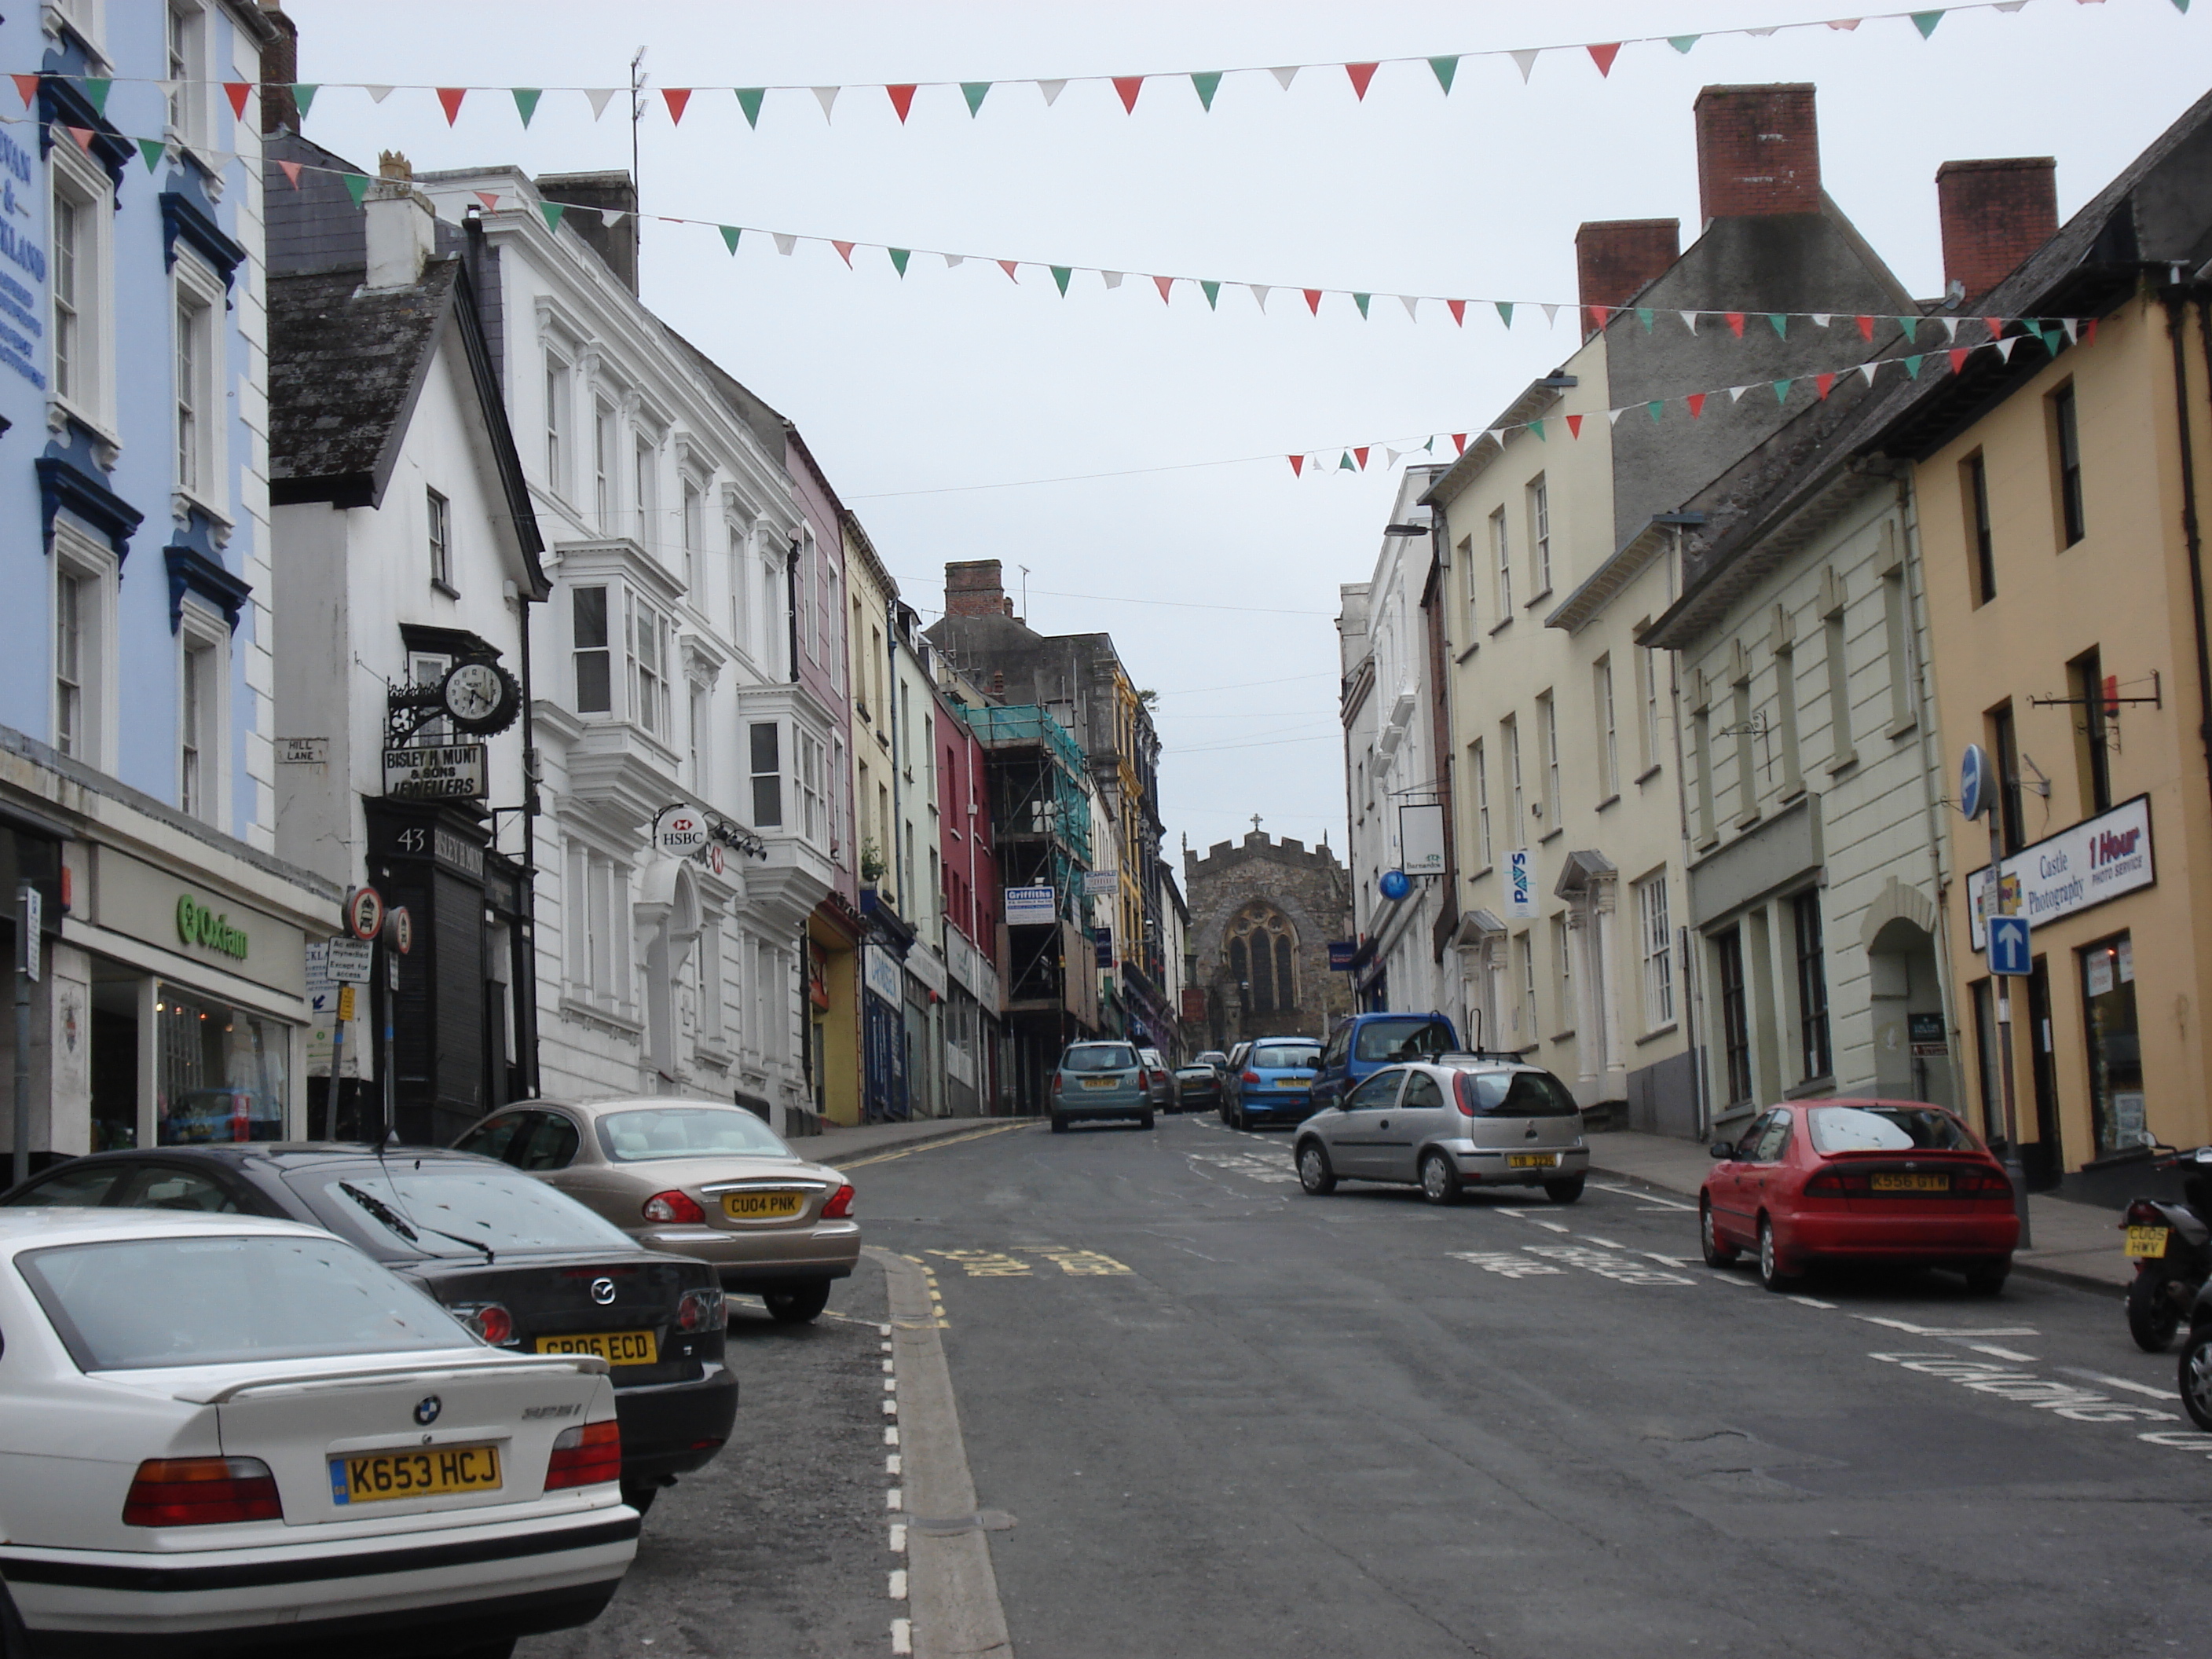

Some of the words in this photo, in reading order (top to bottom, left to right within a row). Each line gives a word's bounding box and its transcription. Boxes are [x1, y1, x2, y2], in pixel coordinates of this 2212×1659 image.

[287, 751, 313, 760] LANE
[288, 740, 313, 750] HILL
[386, 751, 426, 769] BISLEY
[430, 749, 438, 766] H
[443, 747, 478, 765] MUNT
[423, 766, 456, 778] SONS
[390, 778, 474, 798] JEWELLERS
[397, 828, 425, 852] 43
[663, 832, 703, 845] HSBC
[2039, 849, 2068, 881] Castle
[2100, 826, 2141, 866] Hour
[1511, 852, 1529, 904] PAVS
[2091, 866, 2114, 887] PHOTO
[2115, 855, 2143, 877] SERVICE
[1009, 890, 1051, 899] Griffiths
[2028, 875, 2084, 915] Photography
[197, 906, 248, 961] Oxfam
[331, 961, 354, 969] Except
[732, 1198, 767, 1213] CU04
[771, 1196, 795, 1211] PNK
[609, 1335, 647, 1361] ECD
[1867, 1352, 2182, 1423] LOADING
[351, 1456, 432, 1494] K653
[440, 1451, 496, 1486] HCJ
